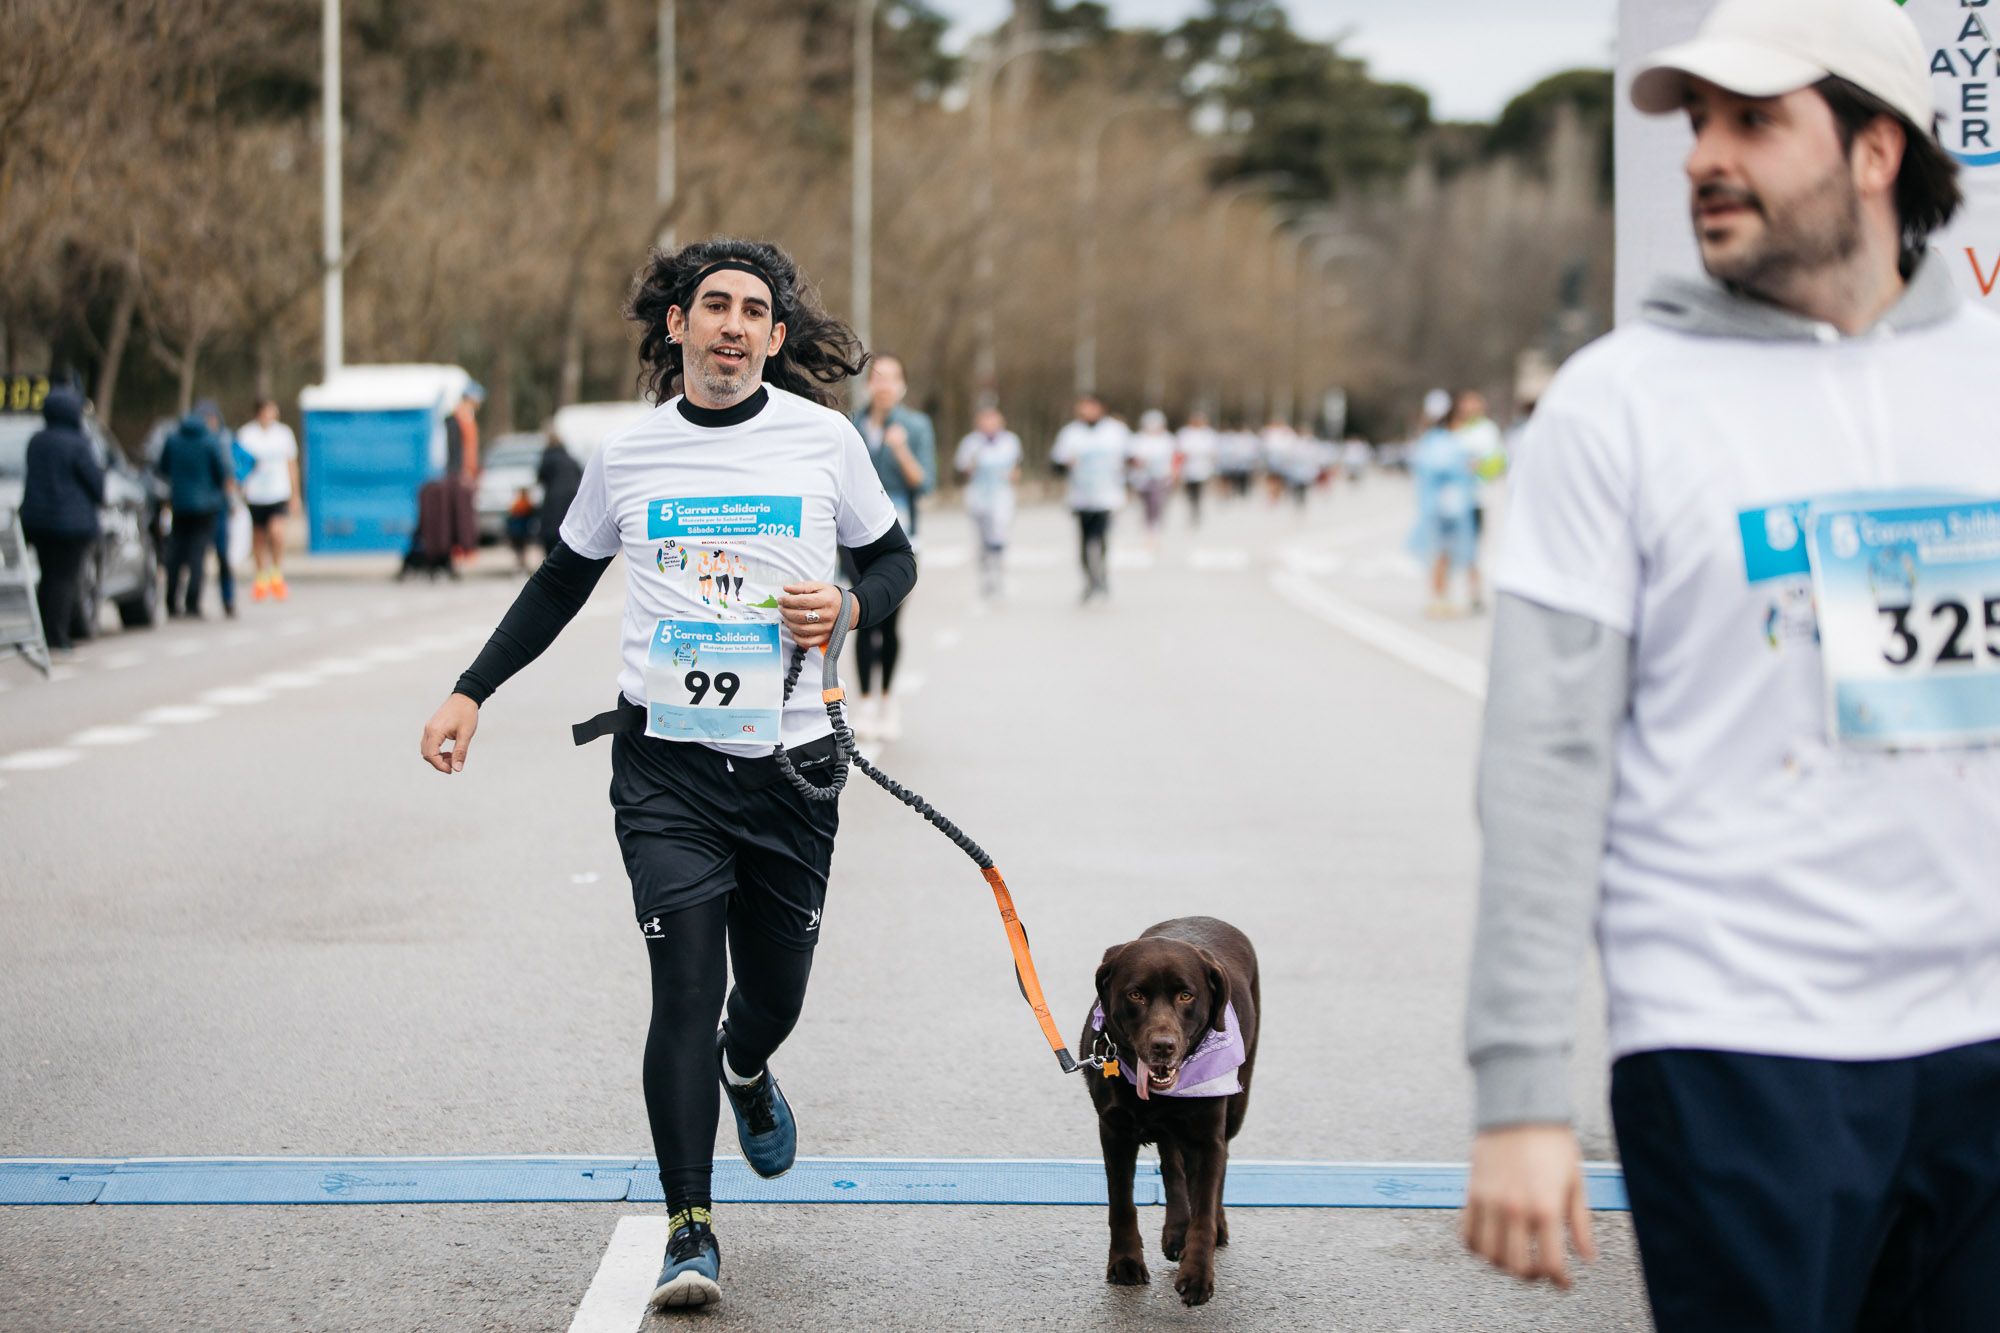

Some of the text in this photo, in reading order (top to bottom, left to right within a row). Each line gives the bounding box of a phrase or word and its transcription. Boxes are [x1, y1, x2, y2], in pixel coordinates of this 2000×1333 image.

[676, 505, 719, 515] Carrera
[721, 502, 771, 514] Solidaria
[687, 525, 715, 534] Sábado
[722, 525, 732, 533] de
[757, 523, 795, 538] 2026
[664, 539, 676, 549] 20
[674, 629, 713, 641] Carrera
[715, 632, 760, 642] Solidaria
[684, 670, 741, 706] 99
[742, 724, 756, 733] CSL
